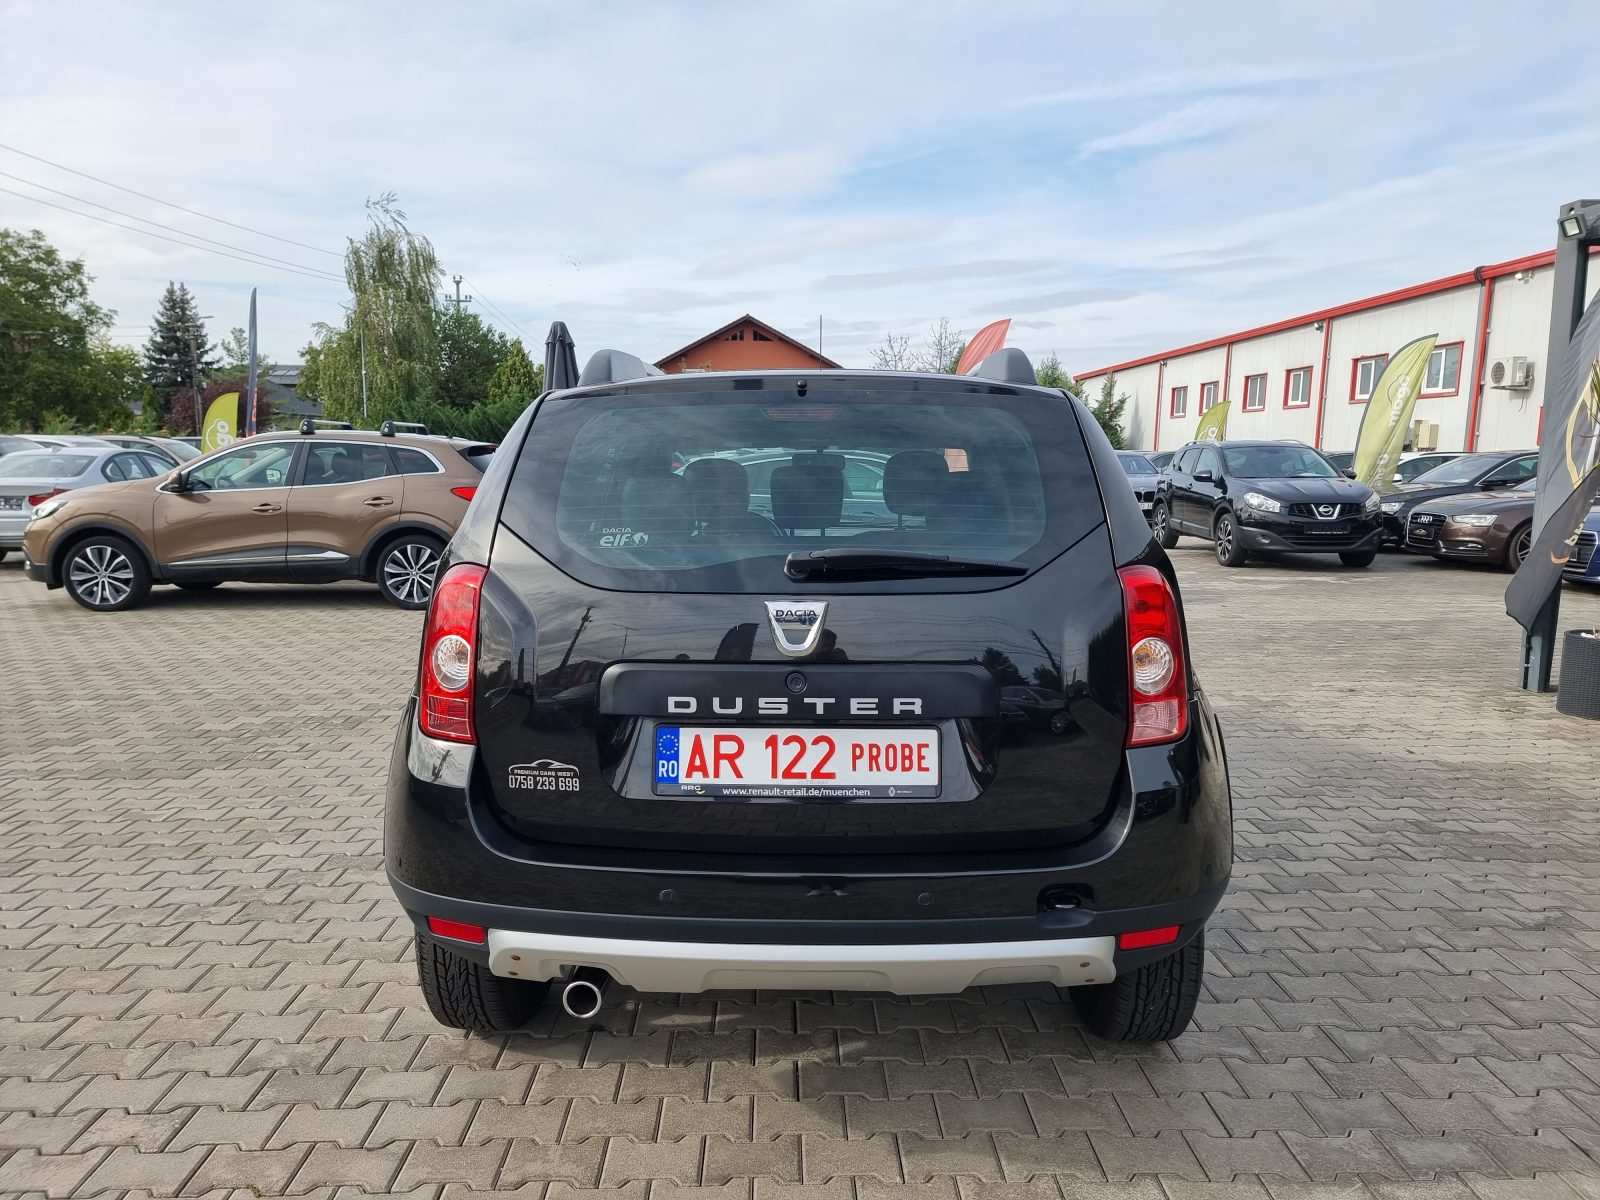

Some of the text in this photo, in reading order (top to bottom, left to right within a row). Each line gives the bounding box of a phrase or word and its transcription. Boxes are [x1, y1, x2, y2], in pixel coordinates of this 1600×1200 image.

[599, 533, 632, 547] elf
[775, 609, 817, 617] DACIA
[667, 696, 923, 715] DUSTER
[685, 734, 930, 780] AR 122 PROBE
[658, 760, 678, 778] RO
[508, 775, 580, 791] 0758 233 699
[722, 786, 871, 797] www.renault-retail.de/muenchen
